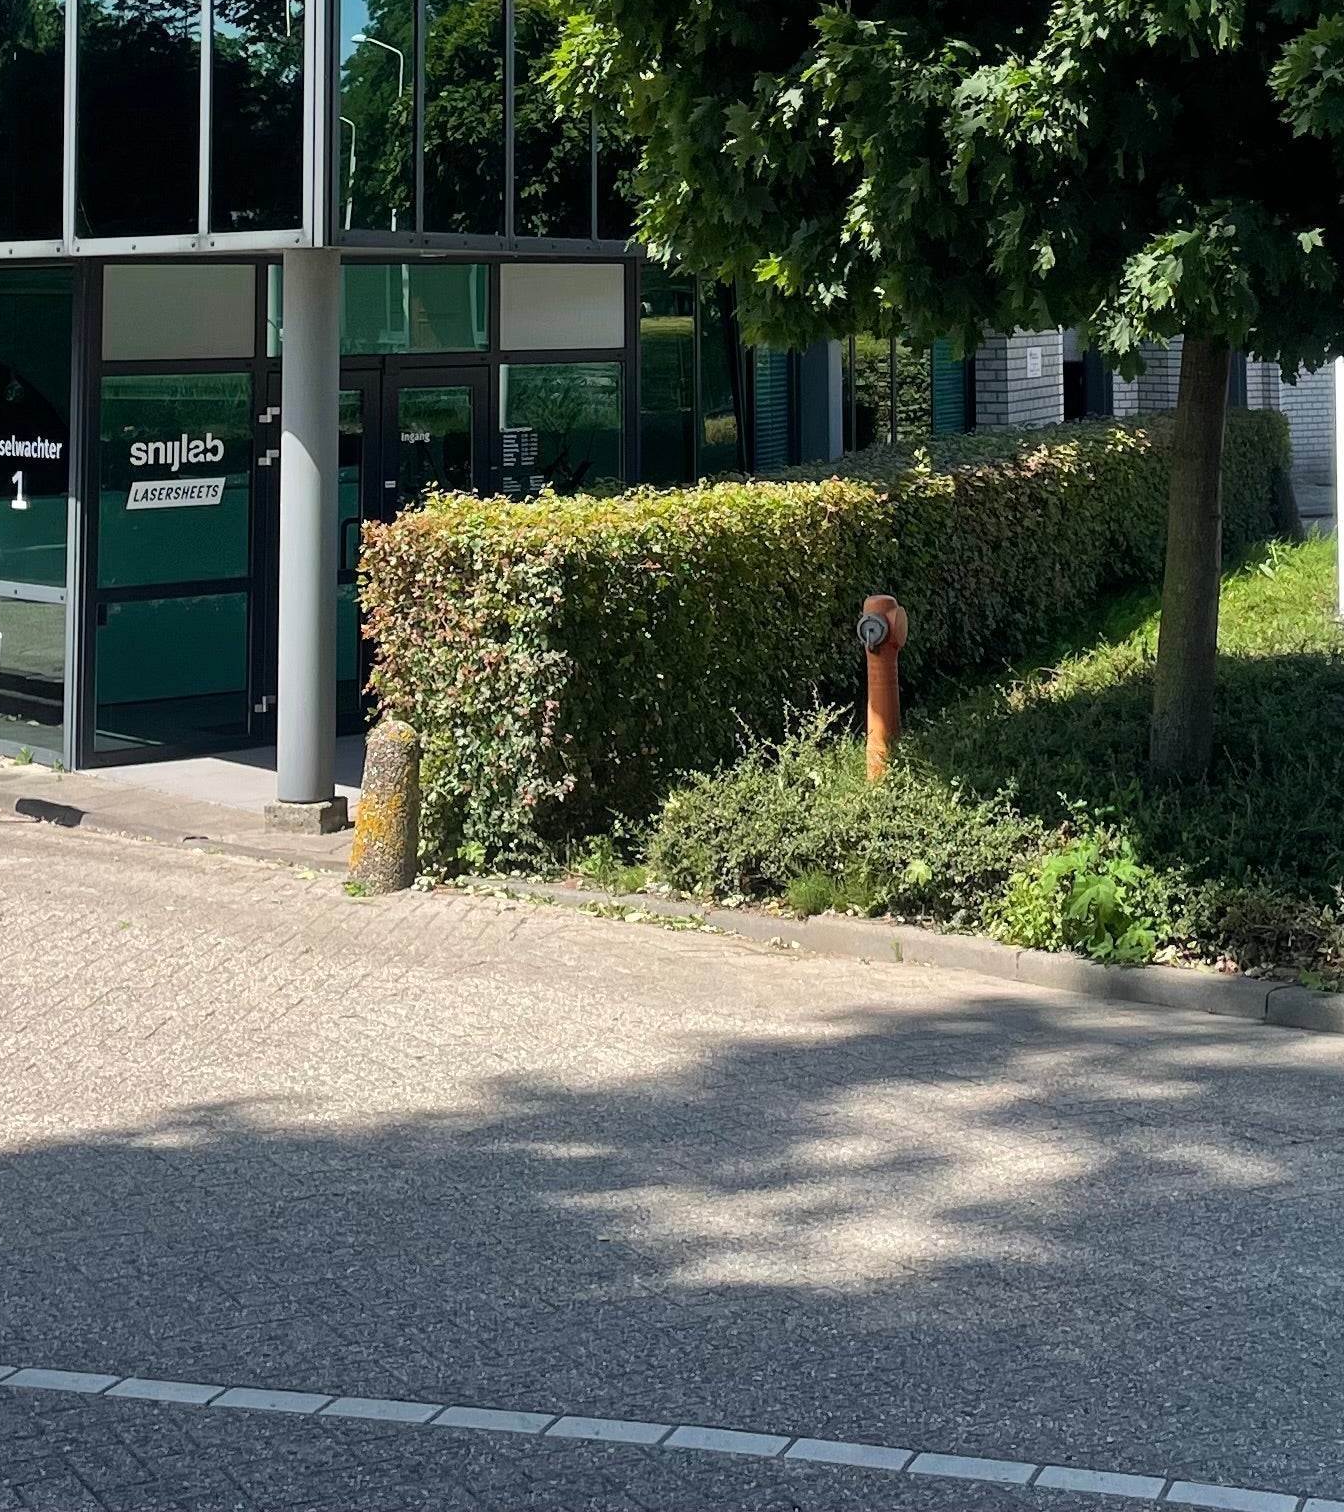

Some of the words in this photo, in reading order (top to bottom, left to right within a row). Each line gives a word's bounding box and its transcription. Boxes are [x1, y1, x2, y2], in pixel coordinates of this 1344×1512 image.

[401, 432, 431, 444] Ingang
[129, 433, 225, 472] snijlab
[11, 470, 28, 510] 1
[133, 484, 219, 502] LASERSHEETS
